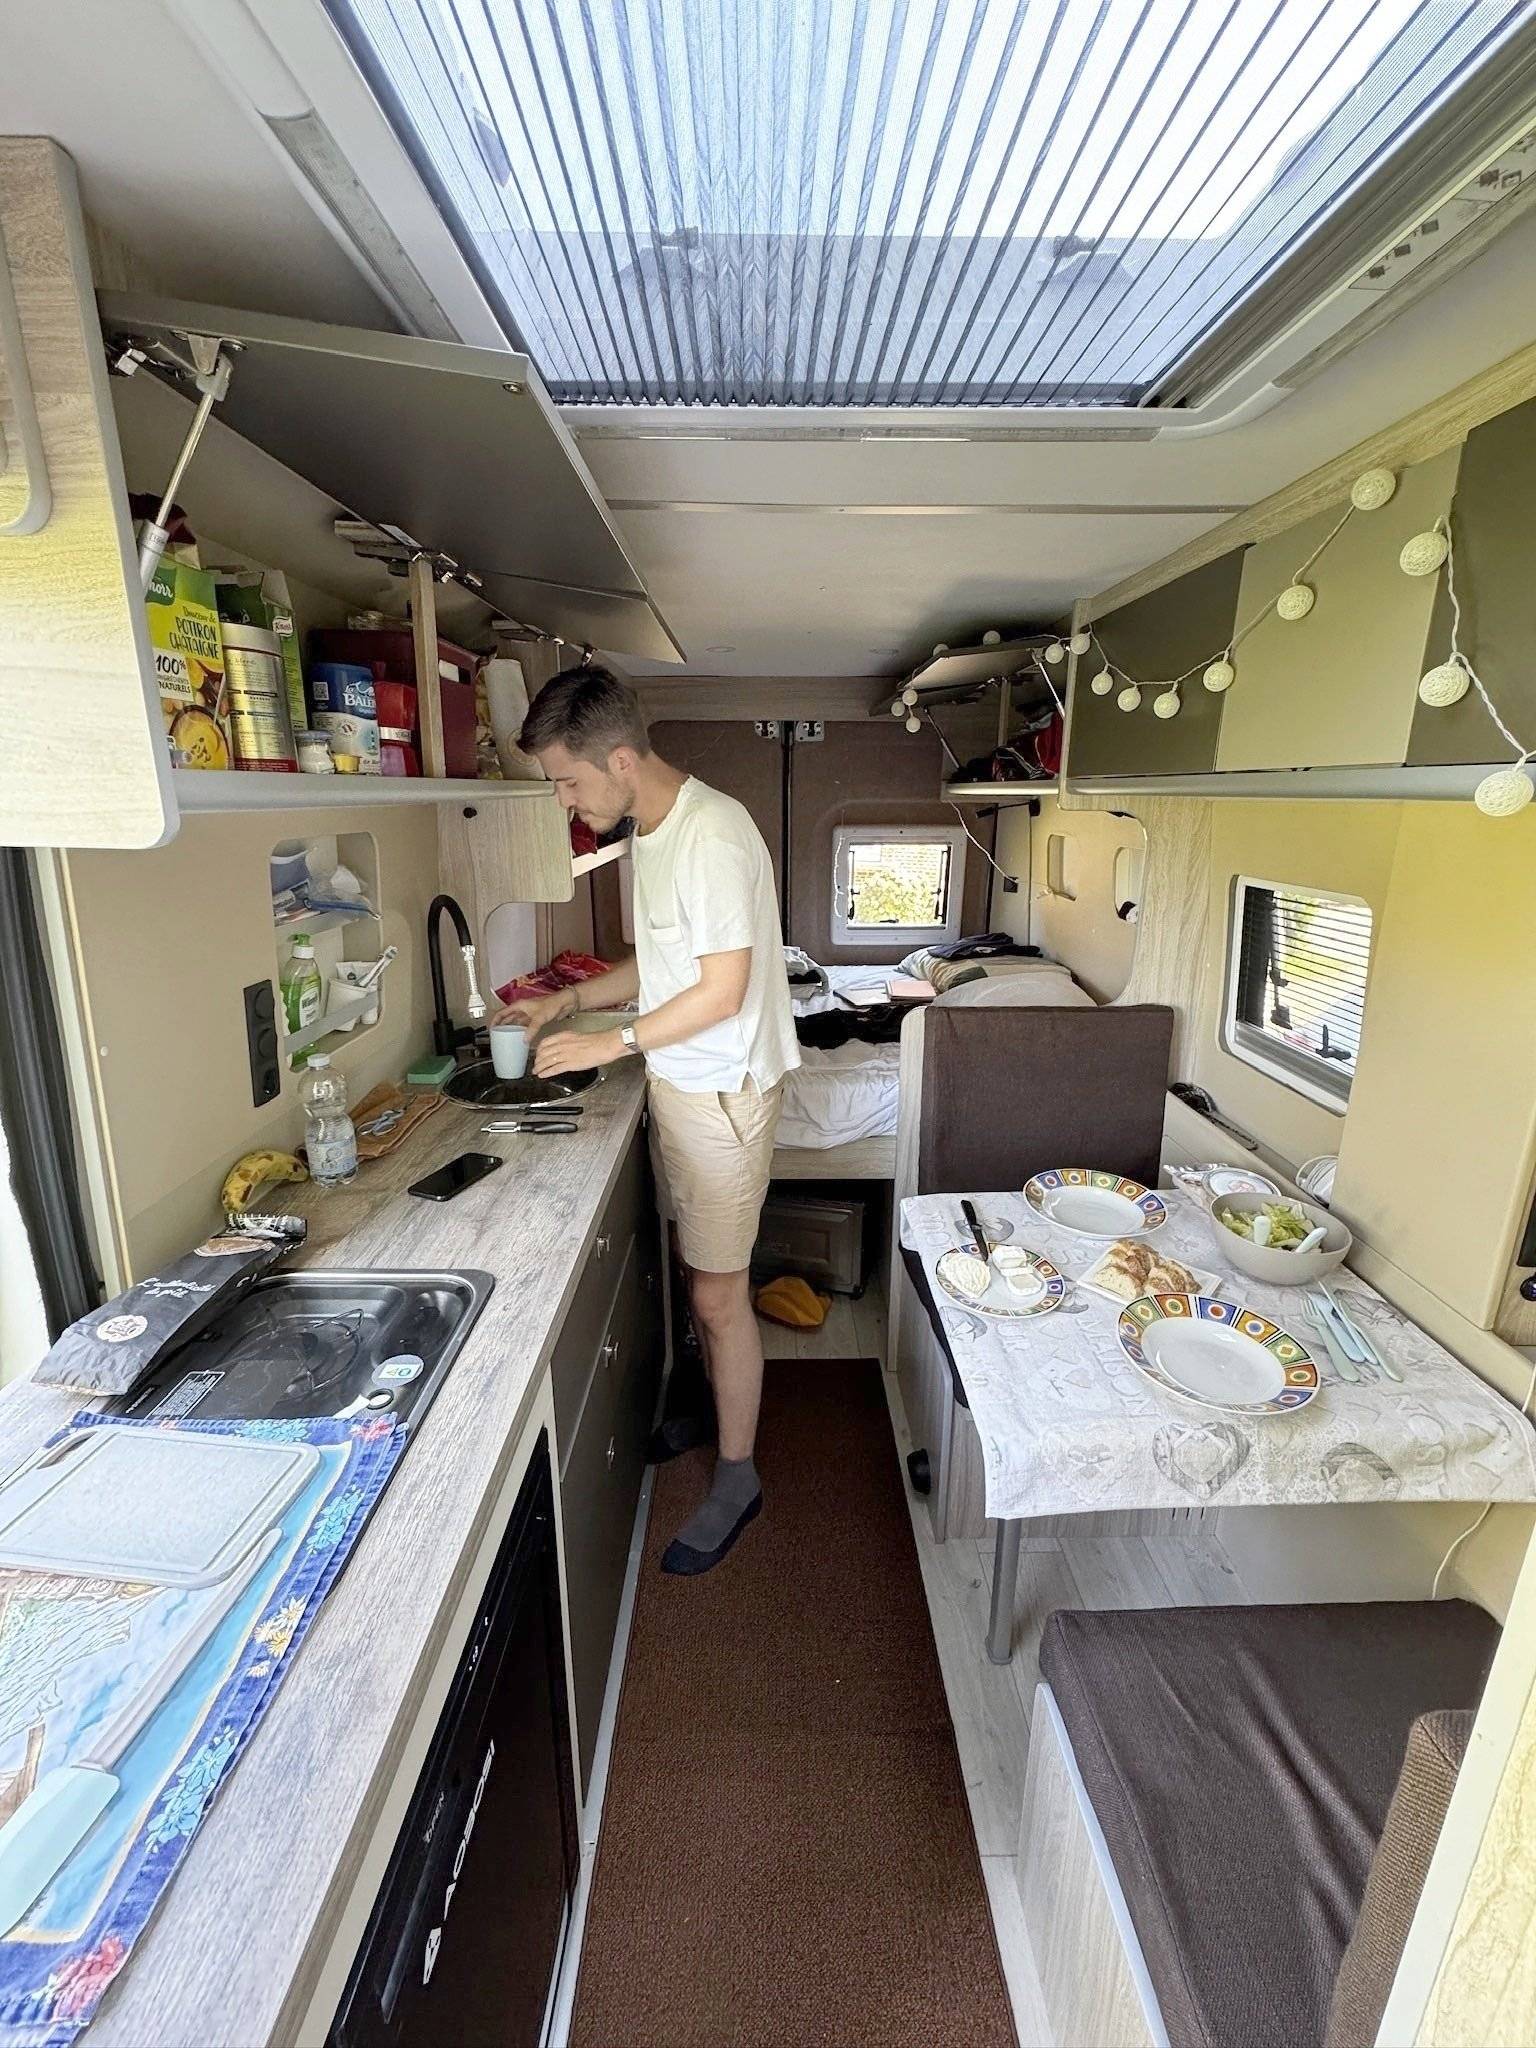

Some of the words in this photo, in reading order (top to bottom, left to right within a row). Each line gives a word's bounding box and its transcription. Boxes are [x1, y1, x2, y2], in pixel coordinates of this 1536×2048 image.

[149, 581, 174, 598] norr
[175, 617, 217, 642] POTIRON
[168, 632, 219, 659] CHATAIGNE
[155, 655, 187, 675] 100%
[158, 680, 191, 694] NATURELS
